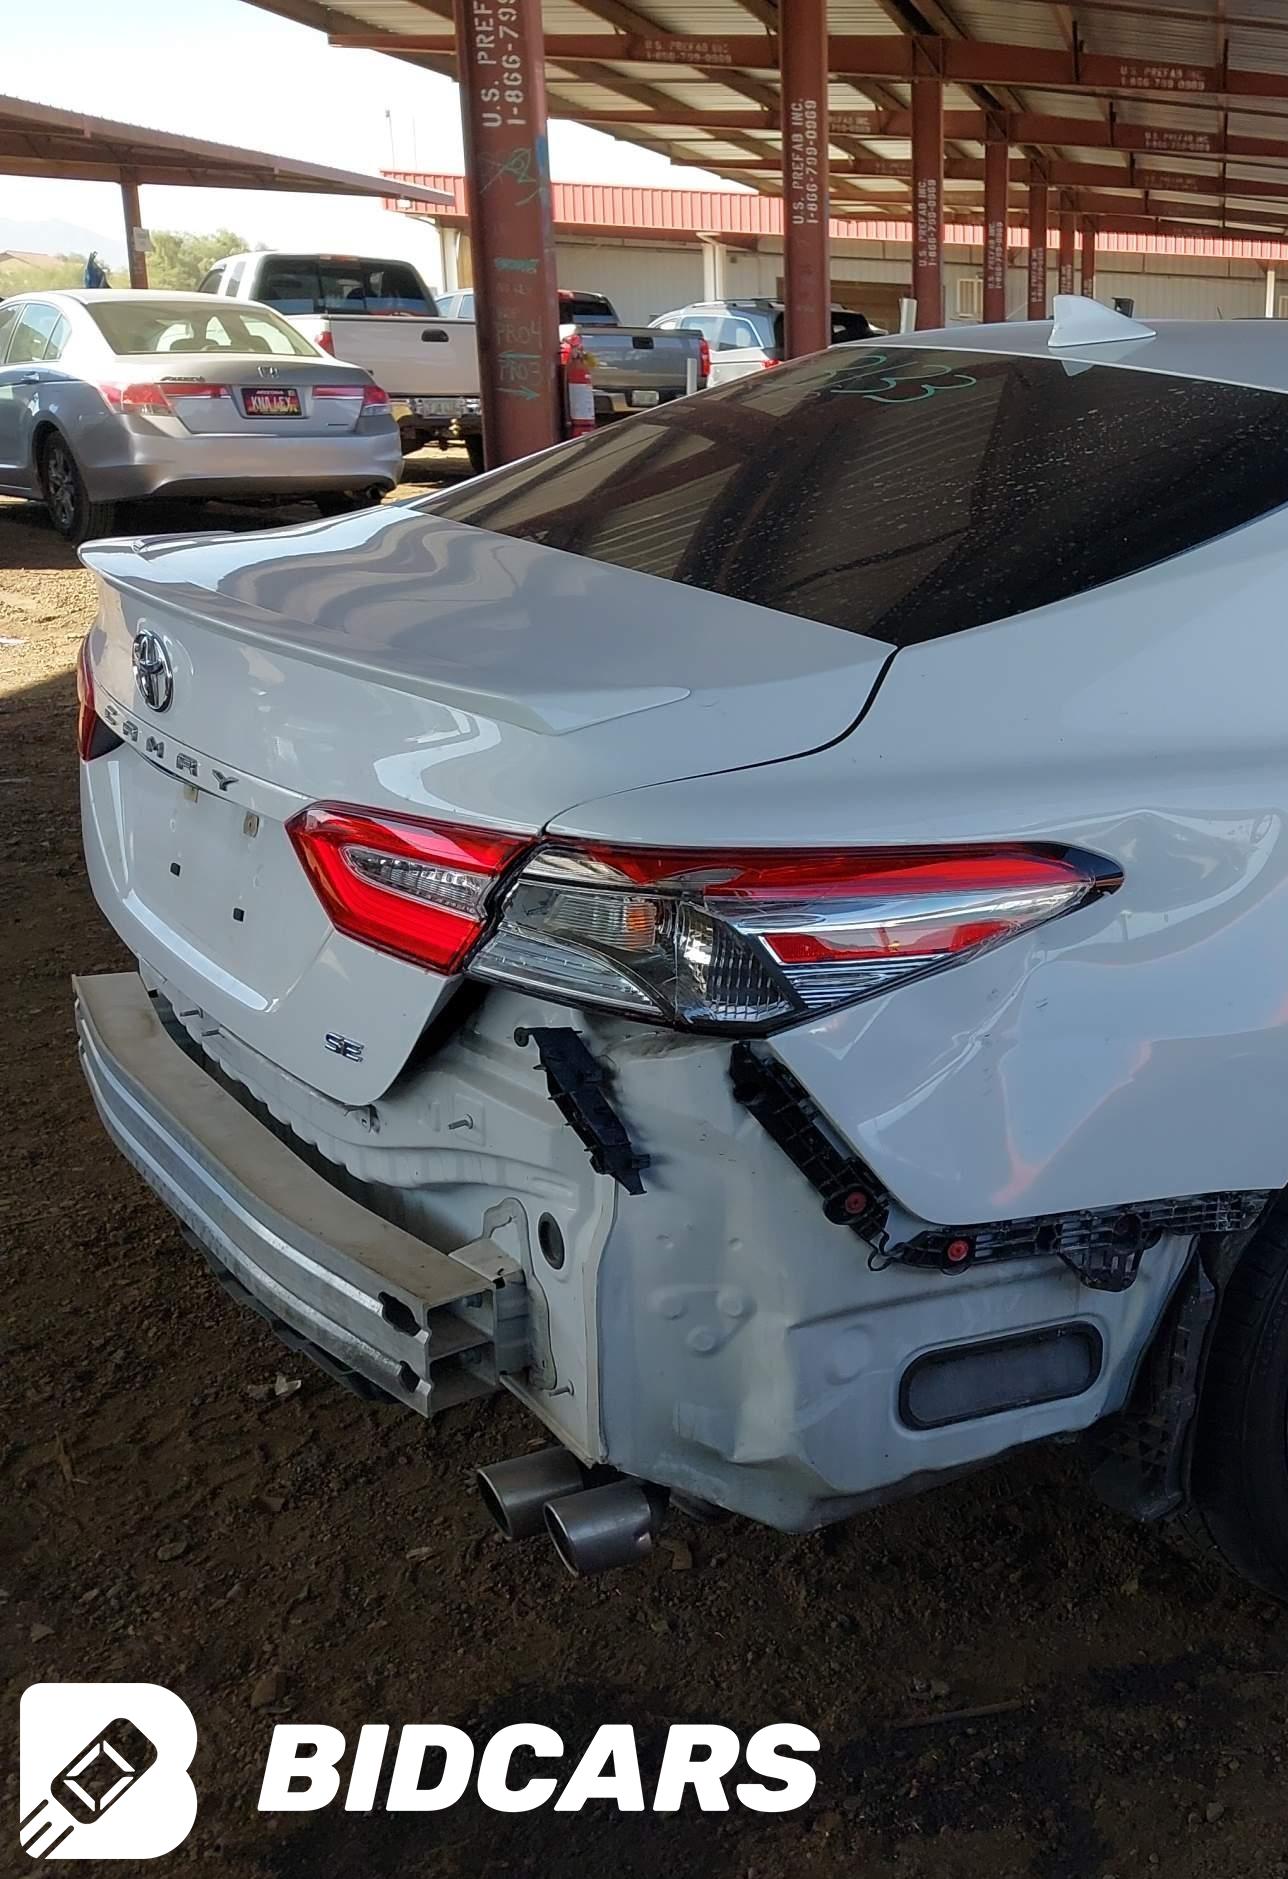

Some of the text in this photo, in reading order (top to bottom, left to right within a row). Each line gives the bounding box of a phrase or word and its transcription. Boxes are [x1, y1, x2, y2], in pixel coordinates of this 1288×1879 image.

[482, 80, 502, 127] U.S.
[791, 98, 805, 225] U.S. PREFAB INC.
[917, 202, 927, 242] PREFAB
[918, 245, 927, 267] U.S.
[104, 704, 240, 791] CAMRY
[325, 1031, 364, 1062] SE
